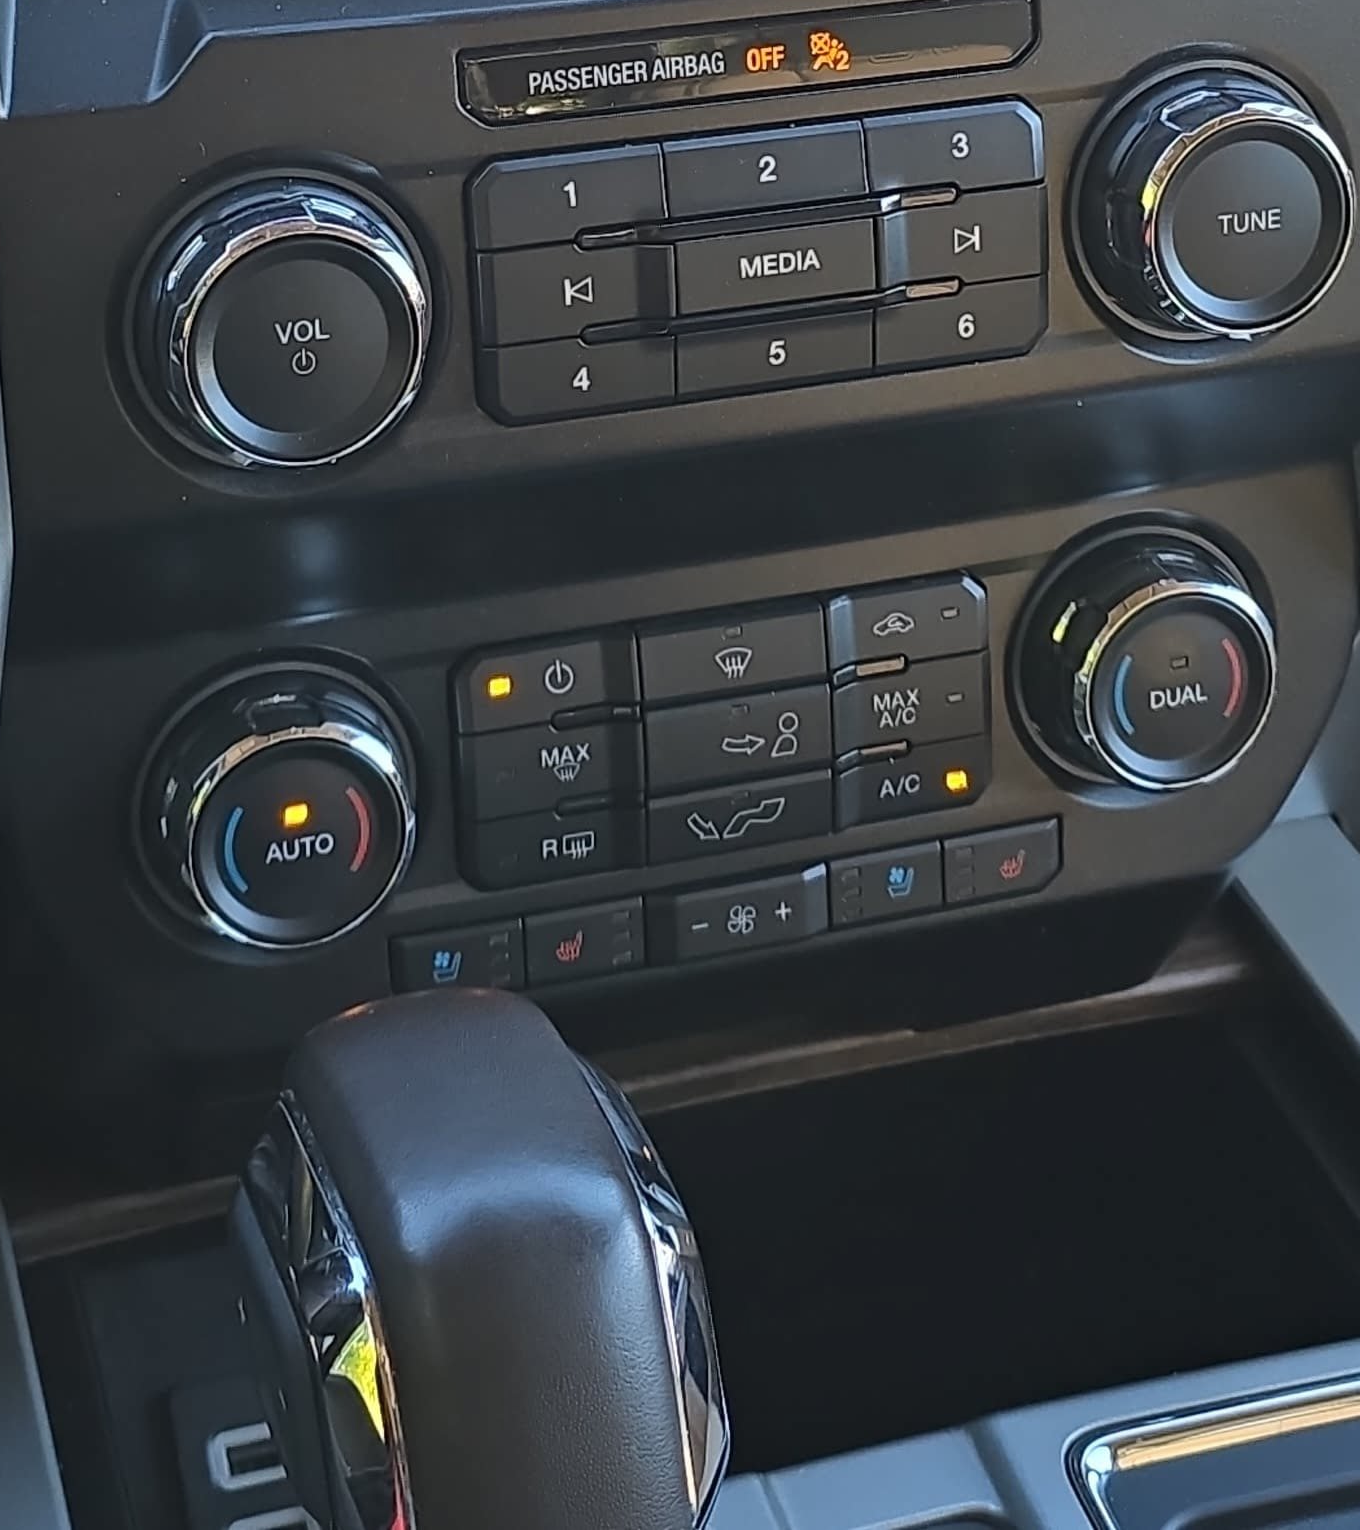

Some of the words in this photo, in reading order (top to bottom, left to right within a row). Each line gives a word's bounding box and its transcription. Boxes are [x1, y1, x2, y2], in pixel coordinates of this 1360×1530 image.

[527, 61, 648, 97] PASSENGER
[652, 51, 726, 83] AIRBAG
[744, 45, 786, 73] OFF
[950, 132, 970, 160] 3
[758, 155, 778, 184] 2
[562, 181, 578, 209] 1
[1216, 208, 1283, 236] TUNE
[739, 246, 822, 280] MEDIA
[274, 317, 331, 346] VOL
[956, 313, 976, 340] 6
[768, 339, 787, 367] 5
[571, 366, 591, 393] 4
[872, 687, 921, 715] MAX
[1149, 682, 1209, 711] DUAL
[879, 703, 917, 728] A/C
[540, 741, 592, 770] MAX
[879, 773, 921, 800] A/C
[264, 832, 335, 865] AUTO
[542, 838, 559, 860] R
